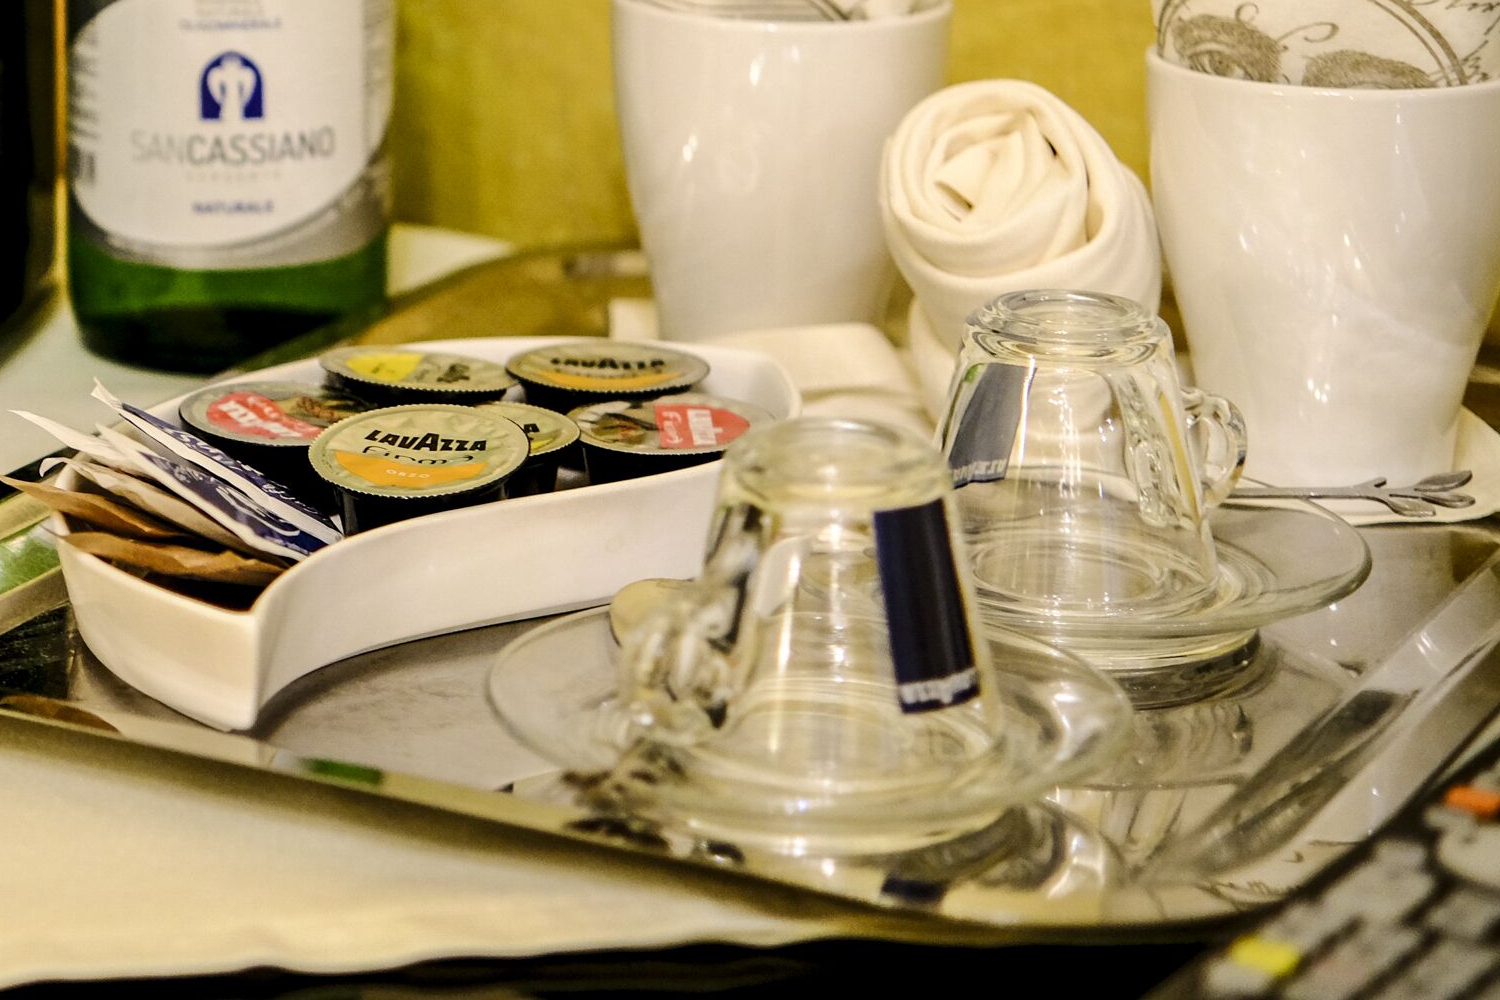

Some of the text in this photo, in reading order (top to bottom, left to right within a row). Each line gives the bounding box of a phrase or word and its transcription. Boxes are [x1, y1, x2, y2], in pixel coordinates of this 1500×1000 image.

[130, 126, 336, 166] SANCASSIANO
[364, 429, 487, 452] LAVAZZA
[386, 469, 430, 479] ORZO
